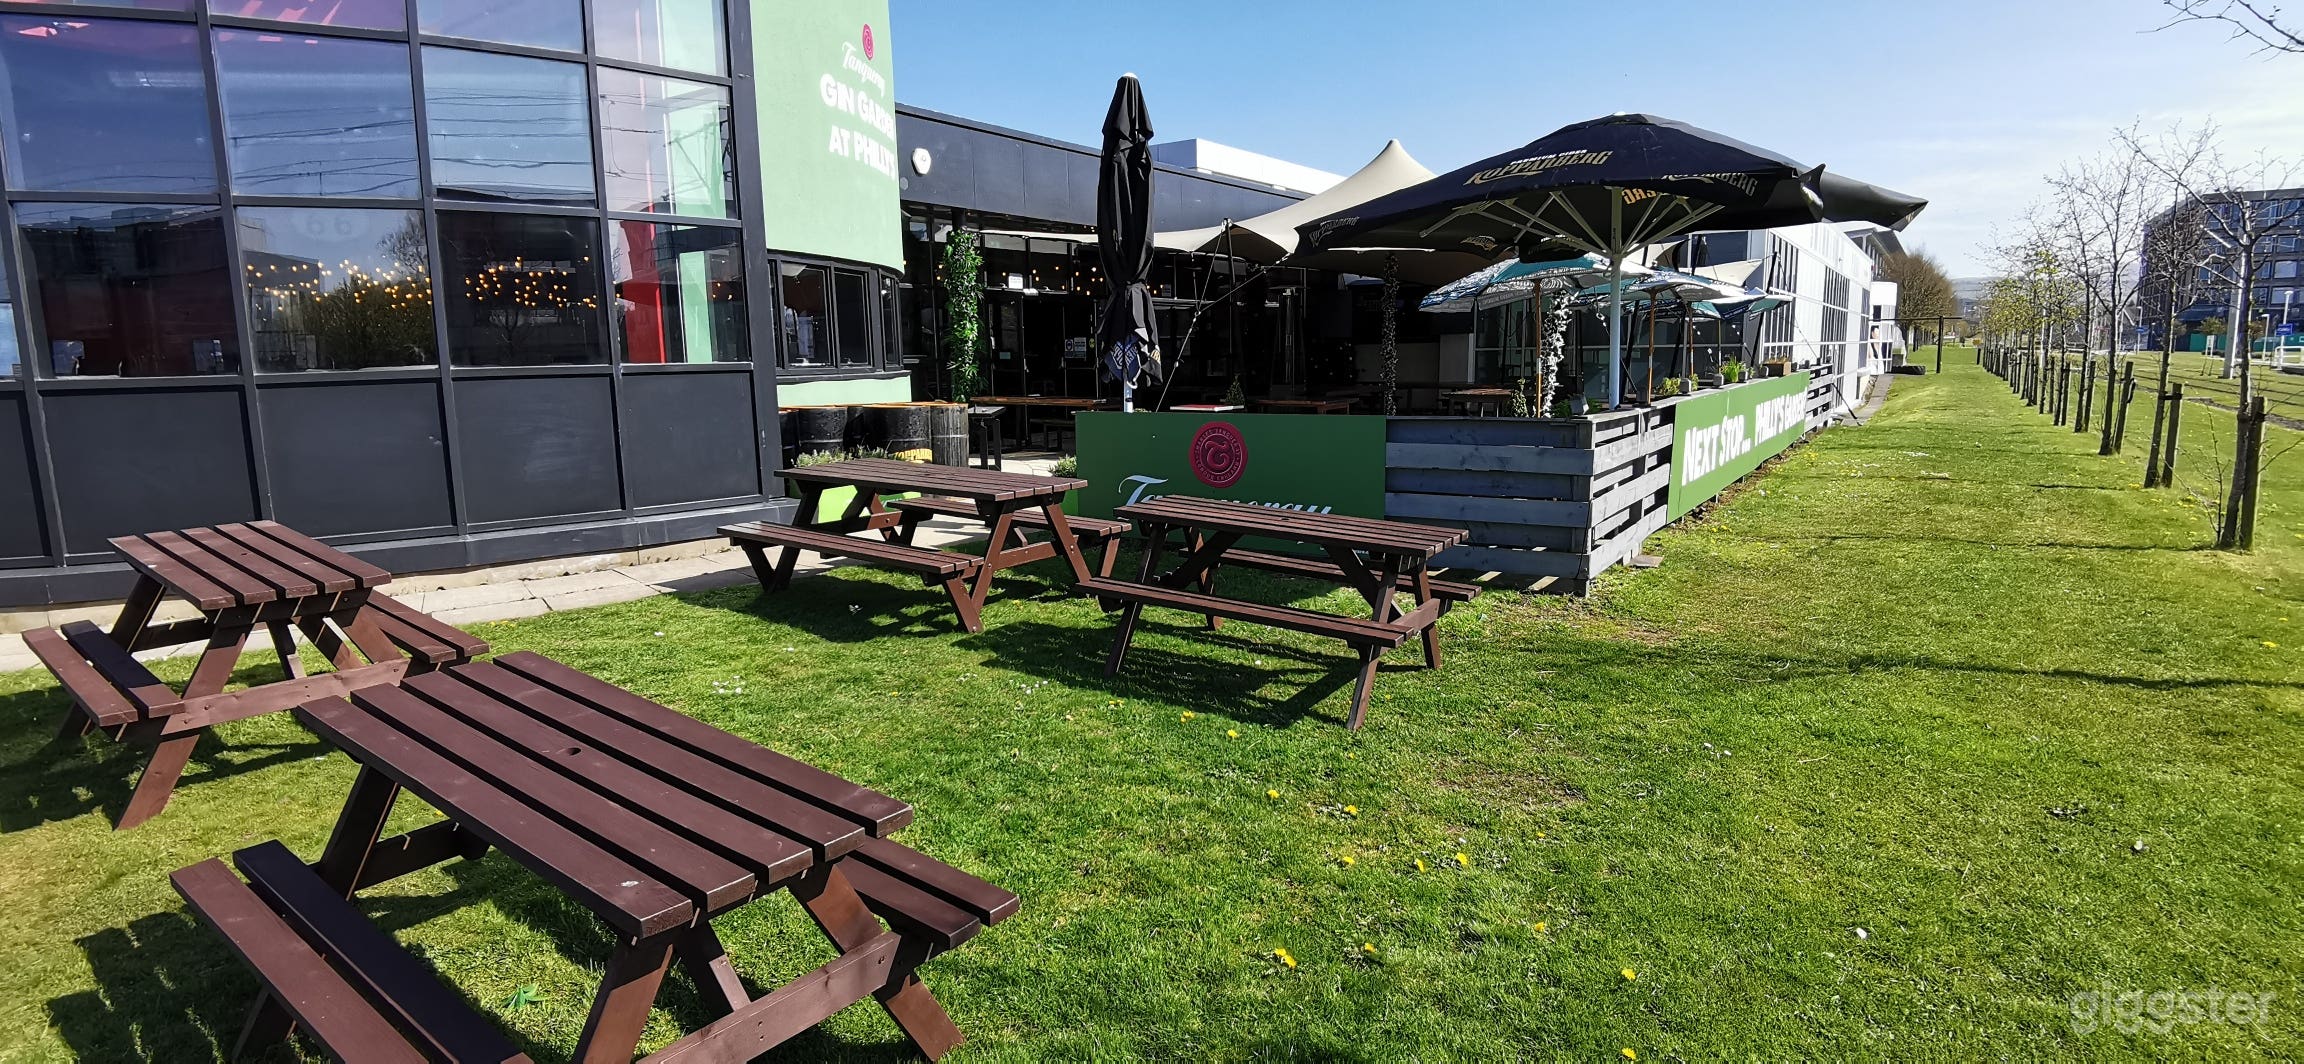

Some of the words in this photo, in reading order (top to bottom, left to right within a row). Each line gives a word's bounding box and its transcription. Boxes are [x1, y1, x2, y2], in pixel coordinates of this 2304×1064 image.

[820, 73, 856, 116] GIN
[857, 90, 895, 142] GARDE
[828, 124, 851, 158] AT
[1463, 150, 1614, 186] KOPPARBERG
[1681, 424, 1720, 487] NEXT
